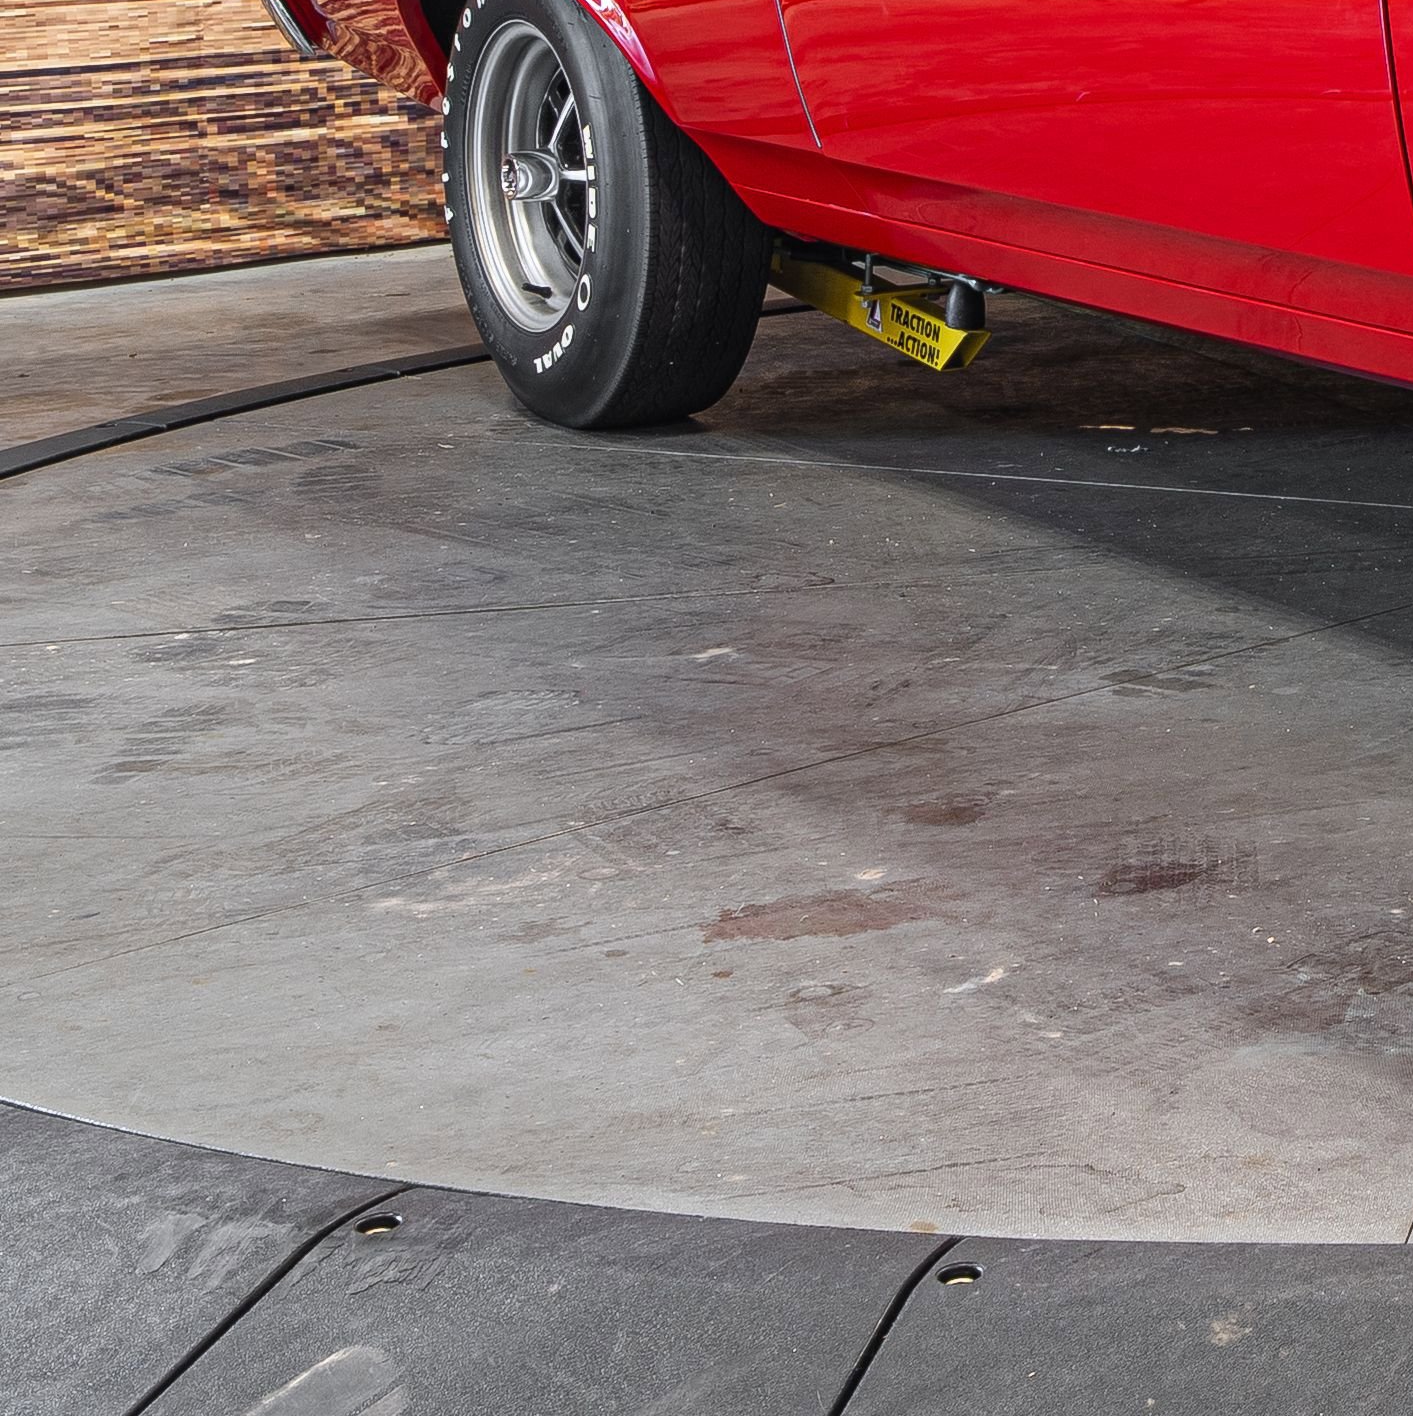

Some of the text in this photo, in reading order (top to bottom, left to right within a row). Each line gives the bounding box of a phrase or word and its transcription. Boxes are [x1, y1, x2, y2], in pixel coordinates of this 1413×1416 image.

[583, 124, 597, 253] WIDE
[533, 323, 575, 374] OVAL
[890, 303, 940, 343] TRACTION
